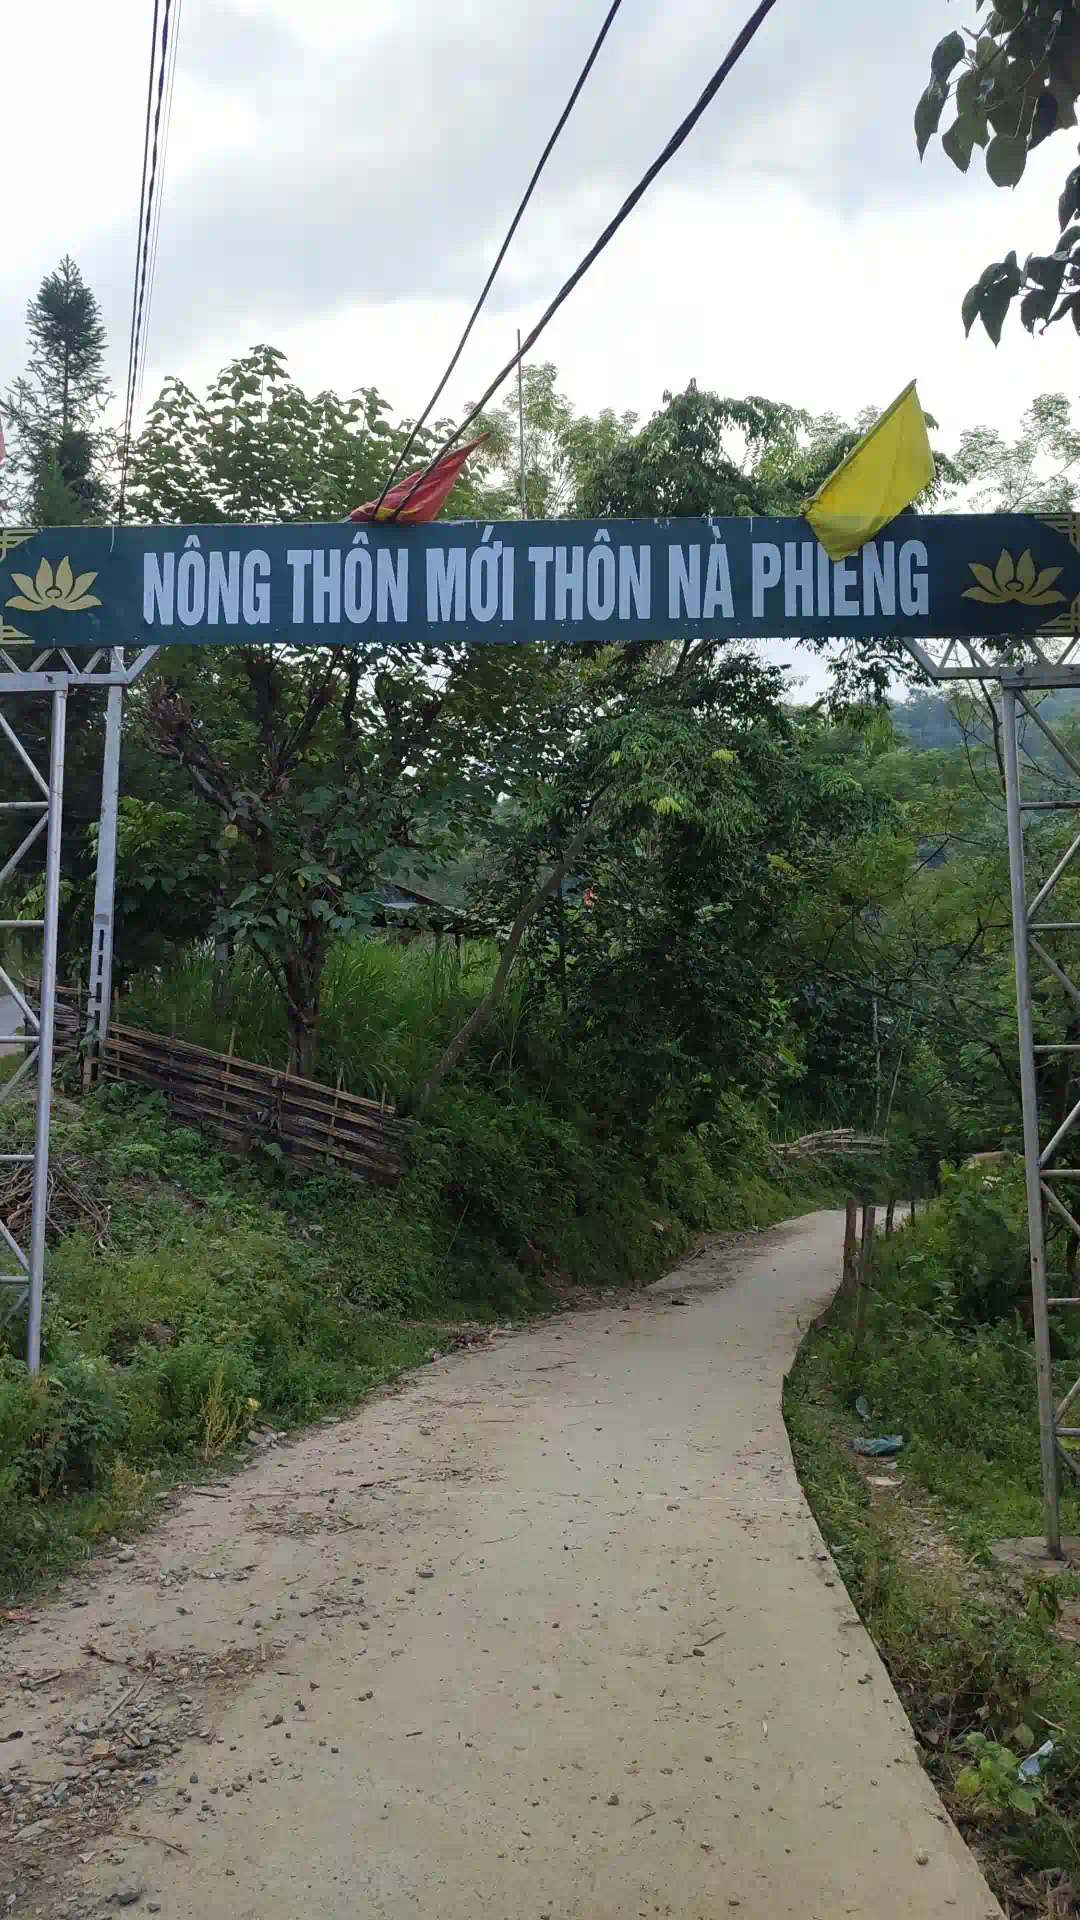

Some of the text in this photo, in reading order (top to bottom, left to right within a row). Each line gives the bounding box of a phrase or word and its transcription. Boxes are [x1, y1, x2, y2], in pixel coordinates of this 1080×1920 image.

[143, 534, 271, 626] NÔNG
[287, 531, 409, 624] THÔN
[425, 525, 515, 622] MỚI
[528, 528, 651, 621] THÔN
[668, 525, 735, 619] NÀ
